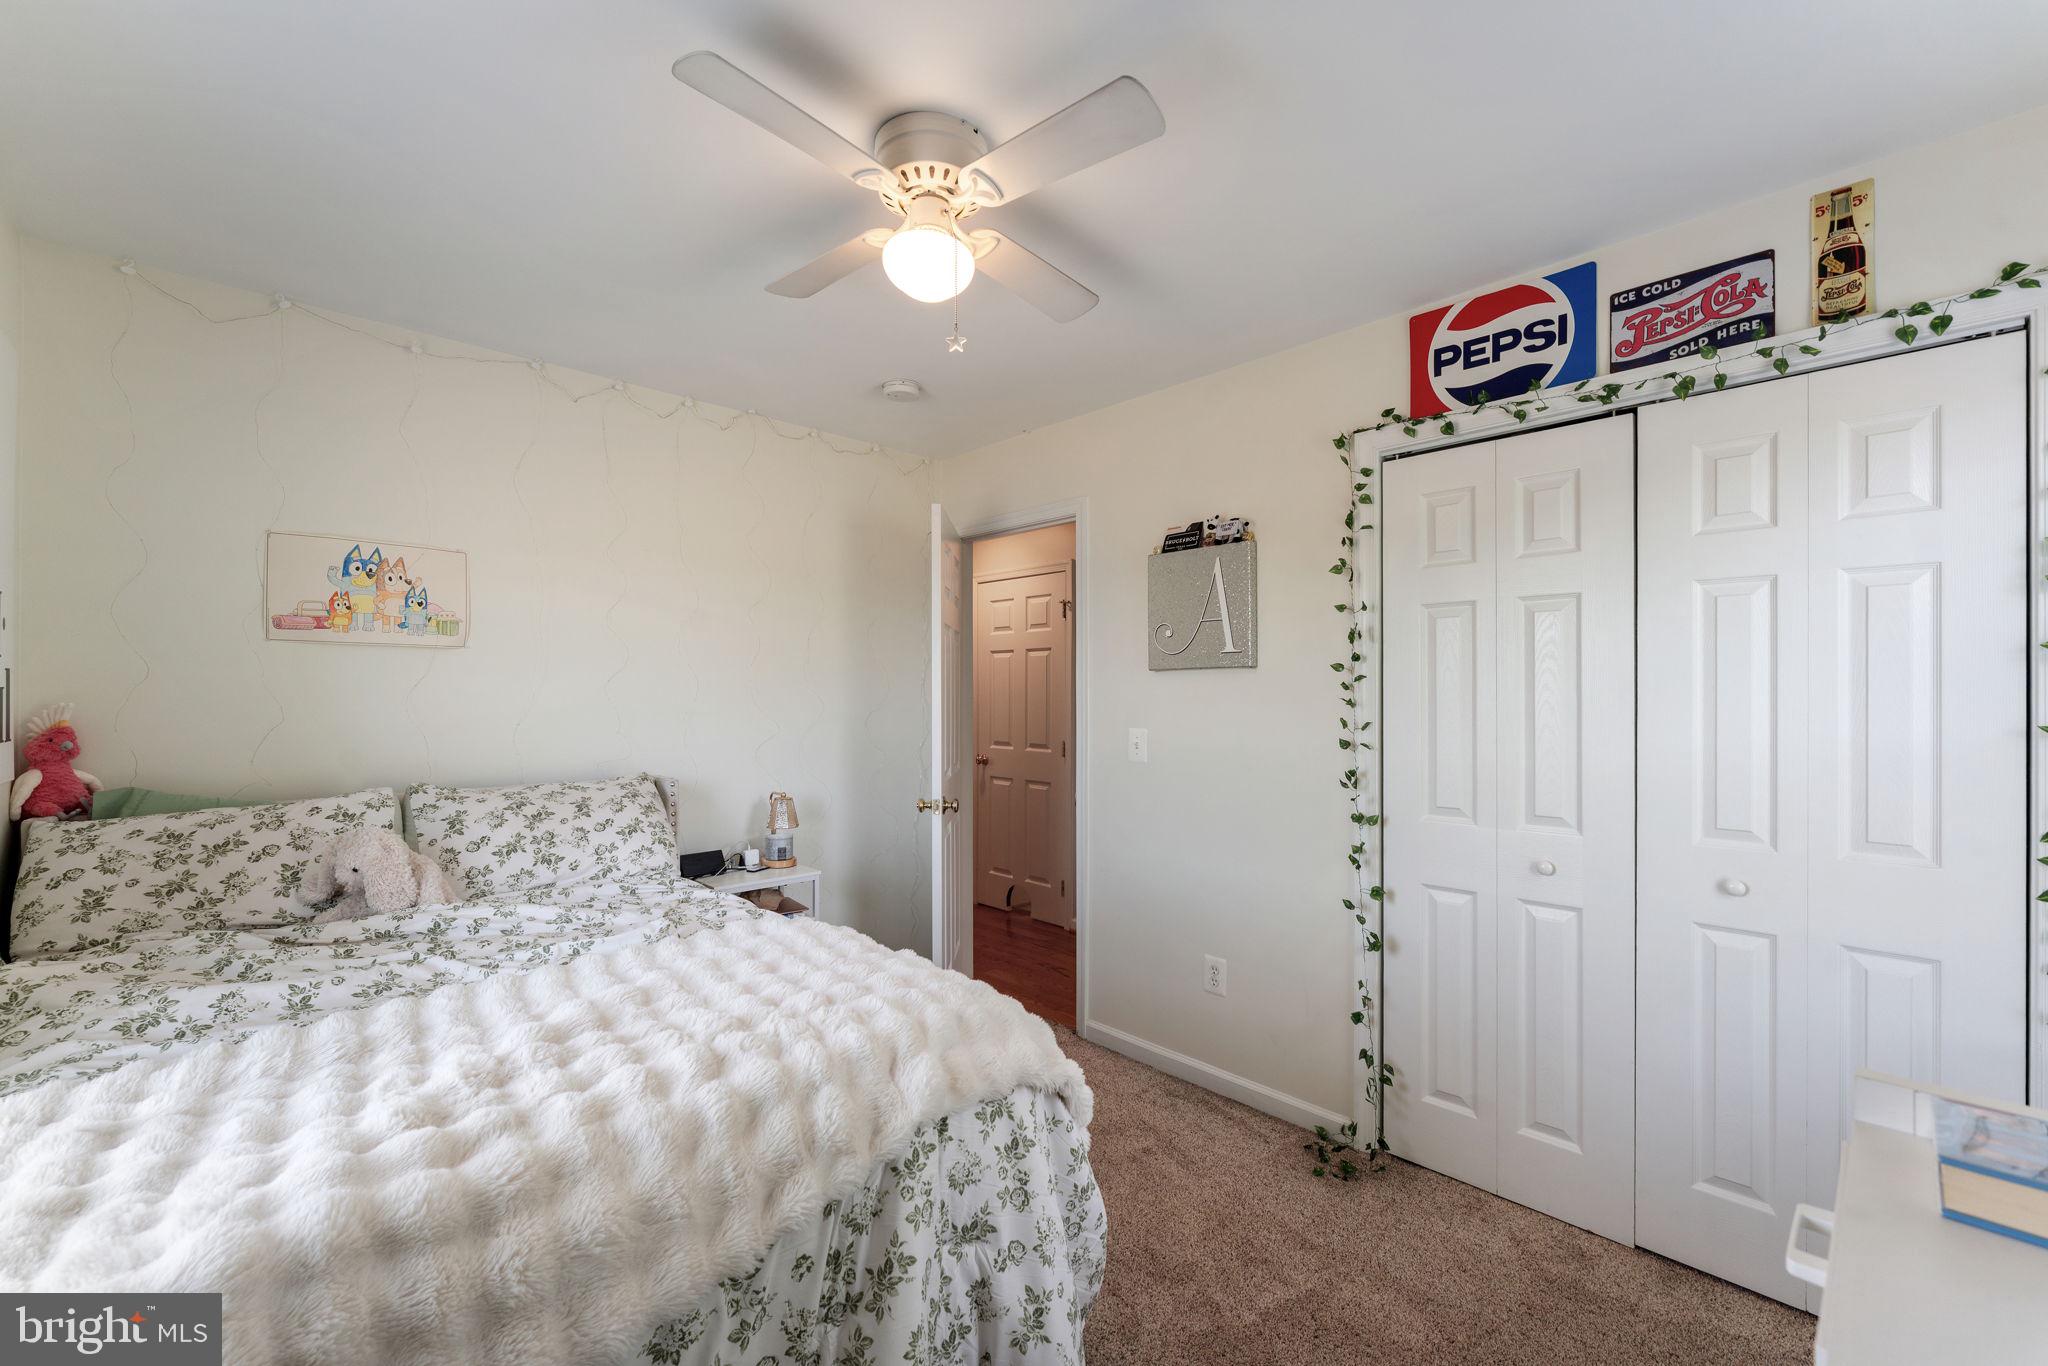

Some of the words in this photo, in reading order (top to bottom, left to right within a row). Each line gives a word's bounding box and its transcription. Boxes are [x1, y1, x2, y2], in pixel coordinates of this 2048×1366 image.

[1614, 291, 1636, 306] ICE
[1641, 278, 1682, 296] COLD
[1434, 313, 1567, 378] PEPSI
[1669, 337, 1709, 360] SOLD
[1717, 319, 1762, 340] HERE
[1155, 555, 1242, 655] A
